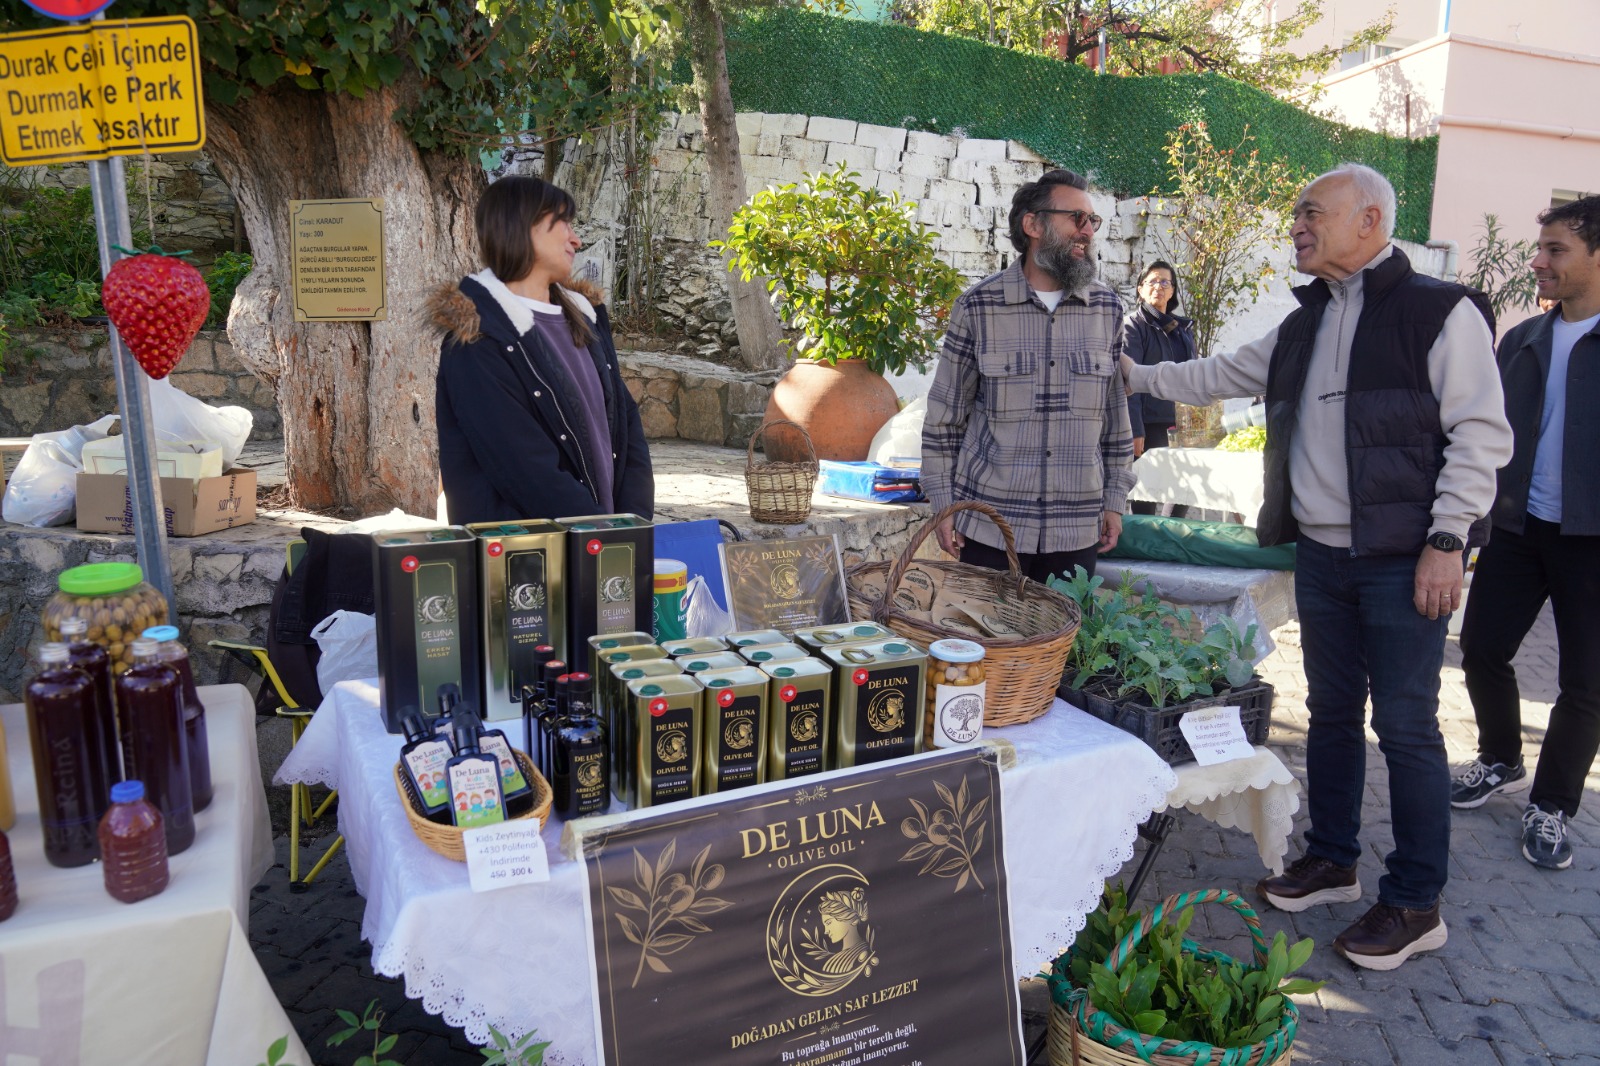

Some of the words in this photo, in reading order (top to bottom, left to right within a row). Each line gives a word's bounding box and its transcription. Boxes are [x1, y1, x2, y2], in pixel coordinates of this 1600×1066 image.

[0, 50, 59, 79] Durak
[112, 34, 187, 71] İçinde
[8, 83, 94, 116] Durmak
[127, 74, 183, 102] Park
[18, 120, 85, 151] Etmek
[316, 217, 344, 225] KARADUT
[762, 551, 775, 560] DE
[776, 549, 802, 558] LUNA
[512, 617, 522, 626] DE
[421, 630, 432, 639] DE
[868, 679, 882, 690] DE
[883, 677, 909, 688] LUNA
[801, 702, 820, 710] LUNA
[725, 710, 735, 718] DE
[736, 709, 756, 717] LUNA
[668, 721, 689, 729] LUNA
[947, 727, 958, 738] DE
[957, 730, 977, 740] LUNA
[866, 738, 890, 749] OLIVE
[891, 736, 905, 745] OIL
[412, 754, 423, 763] De
[423, 746, 445, 758] Luna
[790, 745, 808, 753] OLIVE
[586, 752, 604, 761] LUNA
[723, 753, 742, 761] OLIVE
[455, 769, 467, 777] De
[468, 767, 490, 776] Luna
[656, 767, 676, 775] OLIVE
[739, 821, 790, 859] DE
[797, 800, 886, 845] LUNA
[476, 834, 494, 843] Kids
[777, 846, 826, 869] OLIVE
[829, 840, 856, 856] OIL
[511, 867, 526, 877] 300
[730, 1016, 796, 1049] DOĞADAN
[798, 1003, 842, 1028] GELEN
[845, 994, 869, 1014] SAF
[872, 979, 919, 1005] LEZZET
[781, 1052, 795, 1062] Bu
[796, 1040, 830, 1057] toprağa
[832, 1024, 880, 1046] inanıyoruz.
[854, 1041, 868, 1052] bir
[868, 1031, 894, 1047] tercih
[895, 1023, 918, 1039] değil,
[863, 1041, 909, 1062] inanıyoruz.
